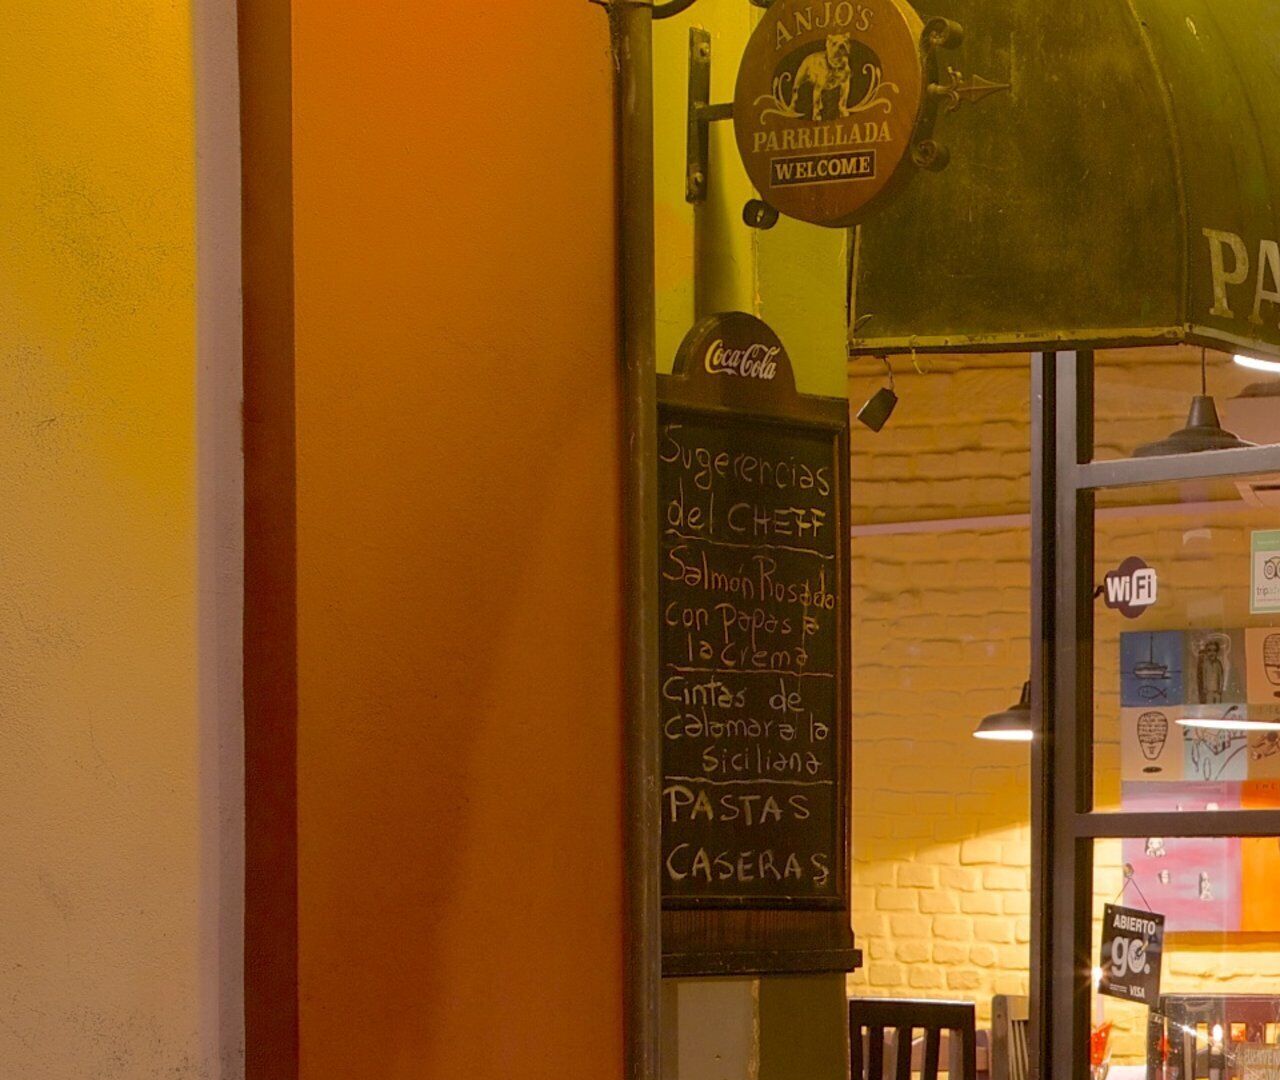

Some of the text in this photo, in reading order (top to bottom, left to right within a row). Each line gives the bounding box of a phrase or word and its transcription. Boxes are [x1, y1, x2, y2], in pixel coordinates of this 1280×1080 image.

[775, 1, 874, 50] ANJO'S
[752, 120, 893, 153] PARRILLADA
[775, 156, 870, 180] WELCOME
[704, 338, 780, 381] Coca-Cola
[660, 424, 830, 496] Sugerencias
[667, 477, 826, 537] del CHEFF
[769, 677, 804, 713] de
[663, 785, 811, 827] PASTAS
[666, 843, 830, 887] CASERAS
[1112, 913, 1156, 936] ABIERTO
[1128, 985, 1146, 998] VISA
